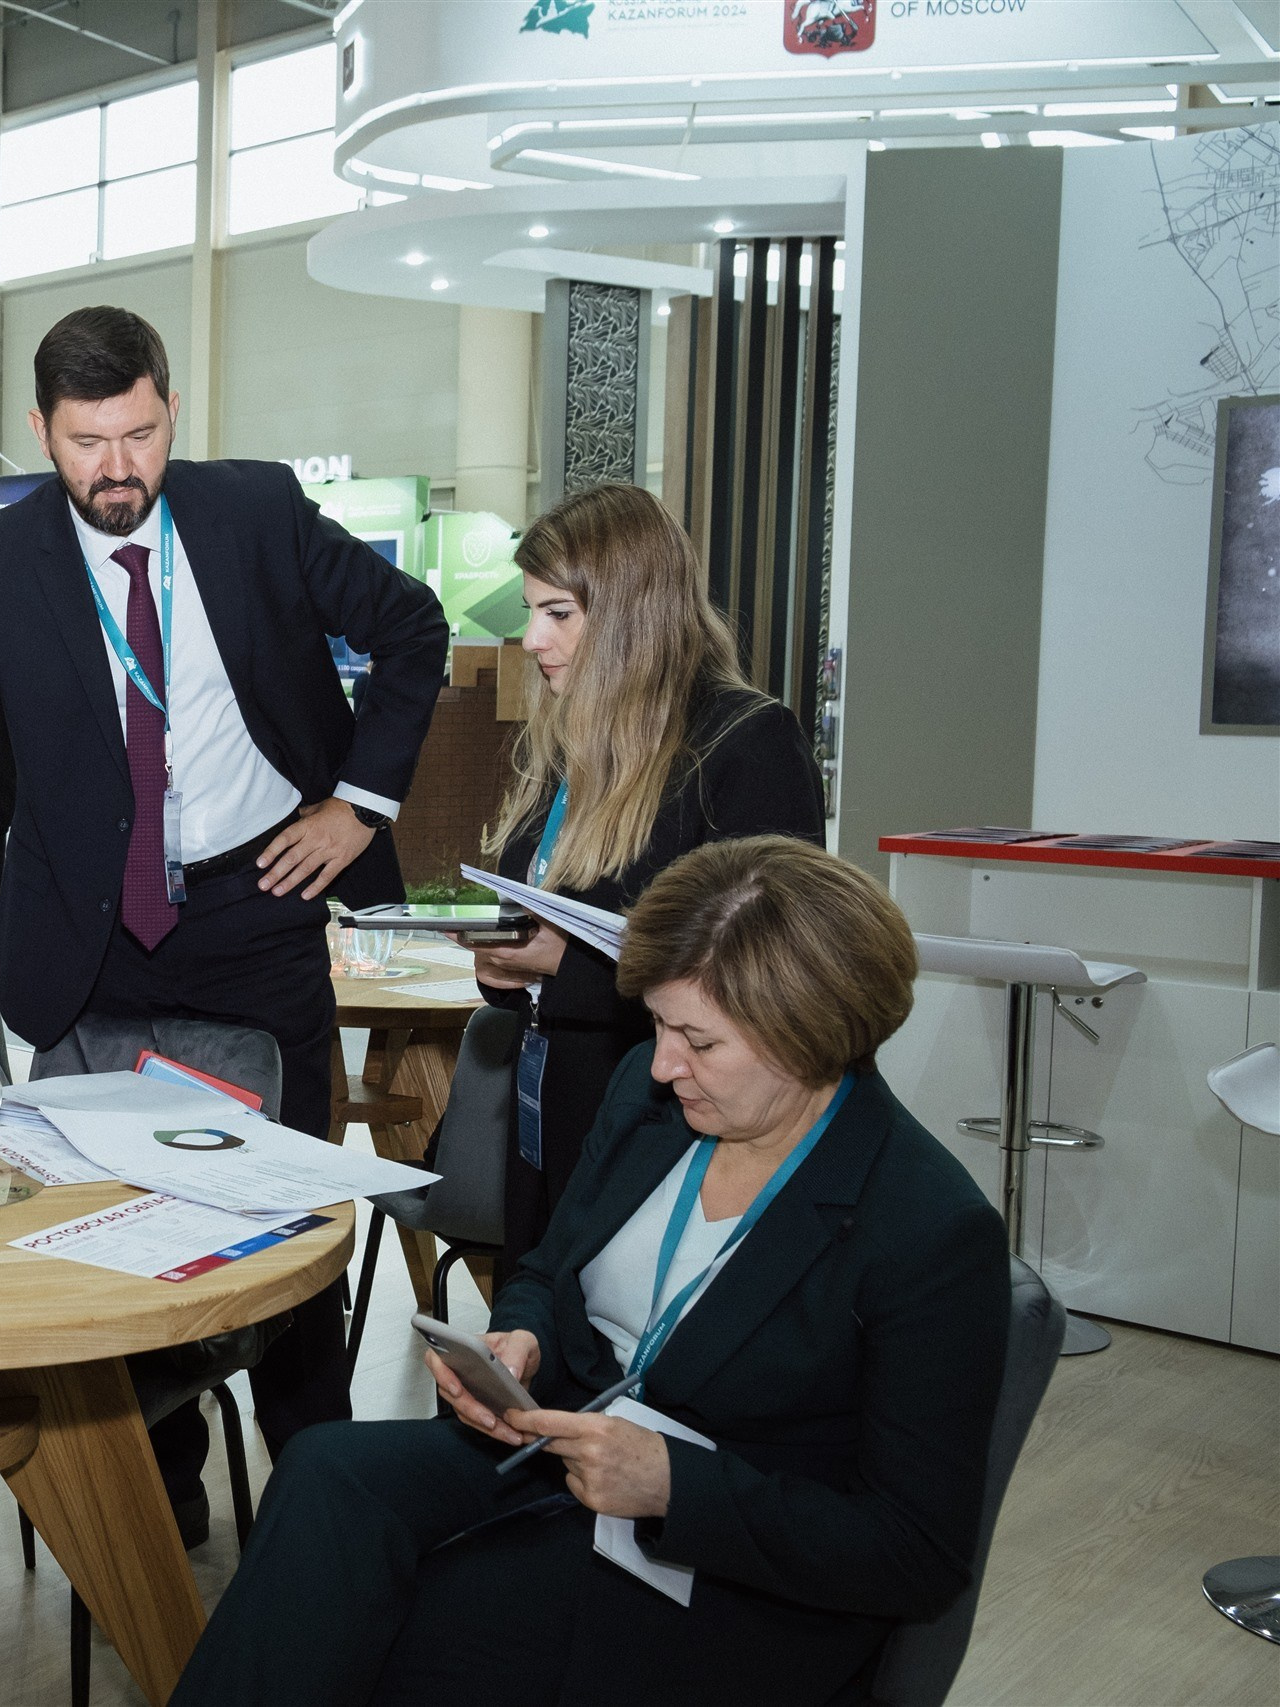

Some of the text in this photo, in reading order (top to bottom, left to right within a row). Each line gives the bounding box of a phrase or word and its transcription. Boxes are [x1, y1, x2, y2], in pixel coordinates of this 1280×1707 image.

[608, 5, 748, 20] KAZANFORUM 2024
[890, 0, 1026, 17] OF MOSCOW
[278, 454, 352, 484] ION
[24, 1211, 124, 1249] РОСТОВСКАЯ
[124, 1194, 177, 1215] ОБЛАС
[636, 1322, 666, 1376] KAZANFORUM
